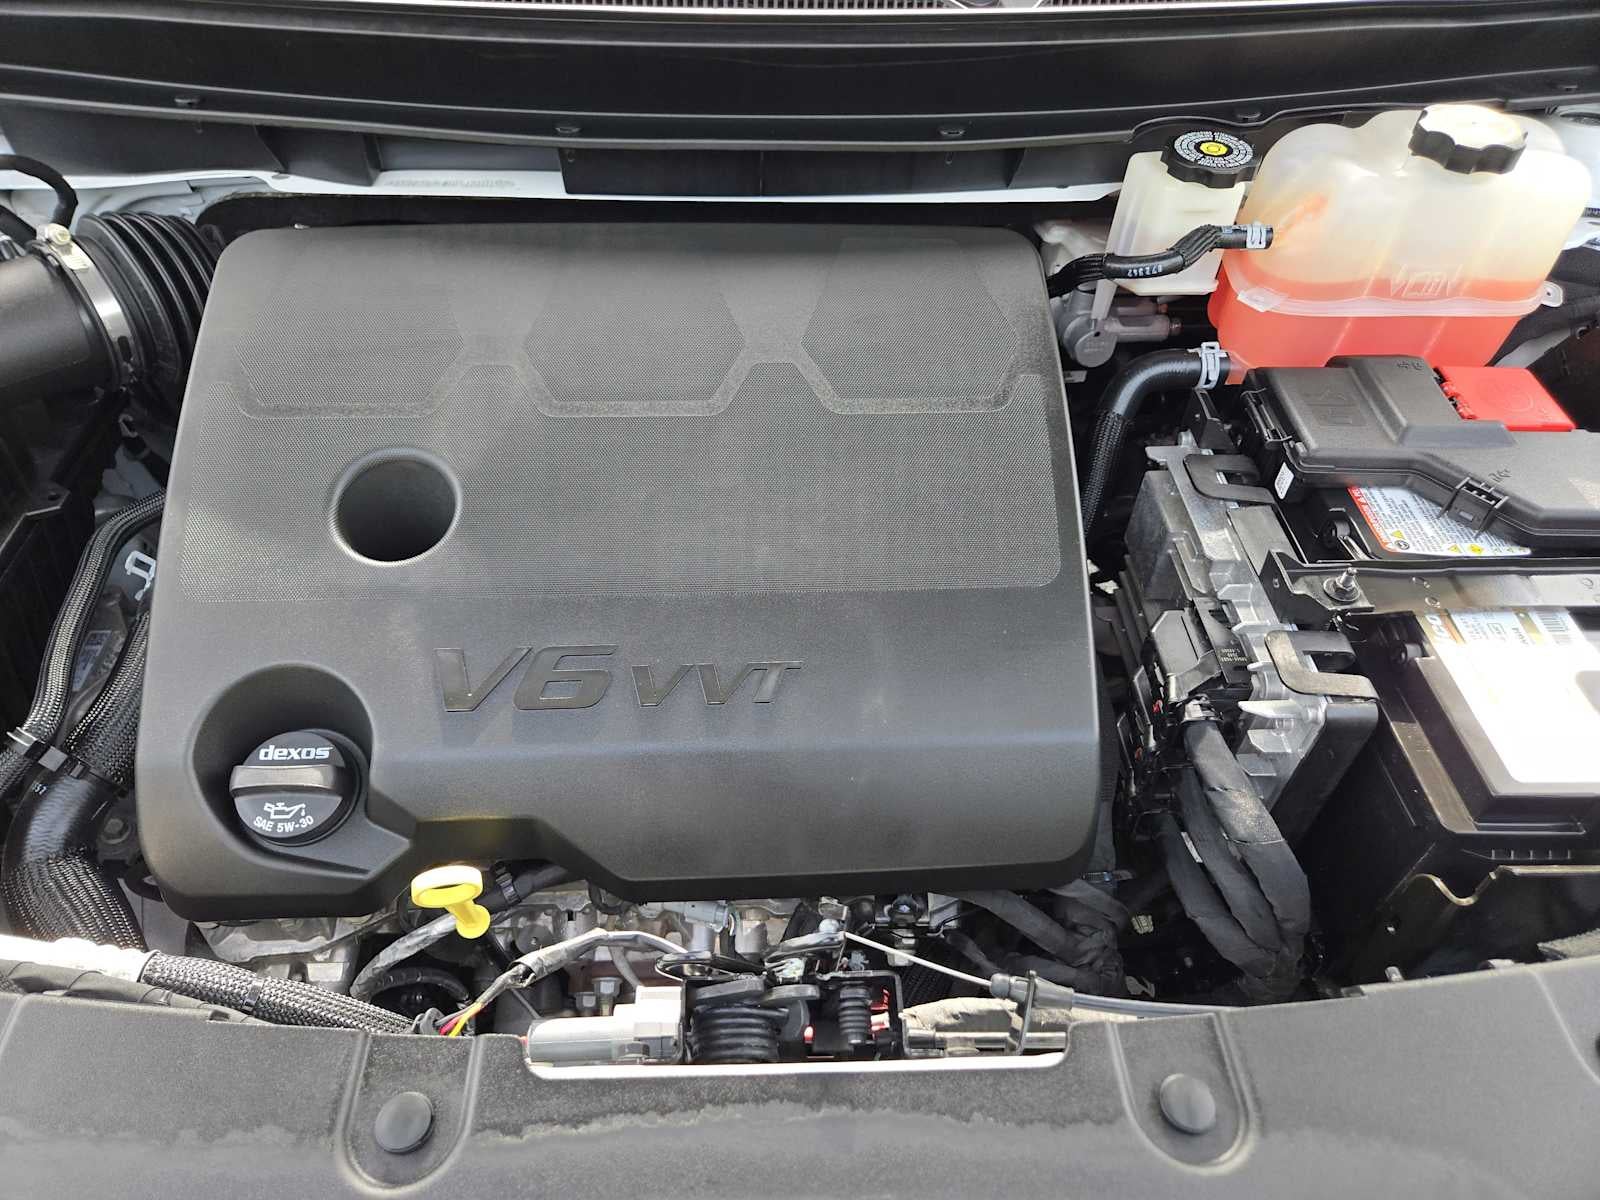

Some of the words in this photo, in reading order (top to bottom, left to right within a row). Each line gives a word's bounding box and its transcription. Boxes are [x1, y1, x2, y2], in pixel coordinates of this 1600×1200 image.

[433, 644, 619, 712] V6
[631, 660, 805, 707] VVT
[258, 744, 334, 761] dexos
[253, 816, 275, 832] SAE
[276, 815, 315, 833] 5W-30
